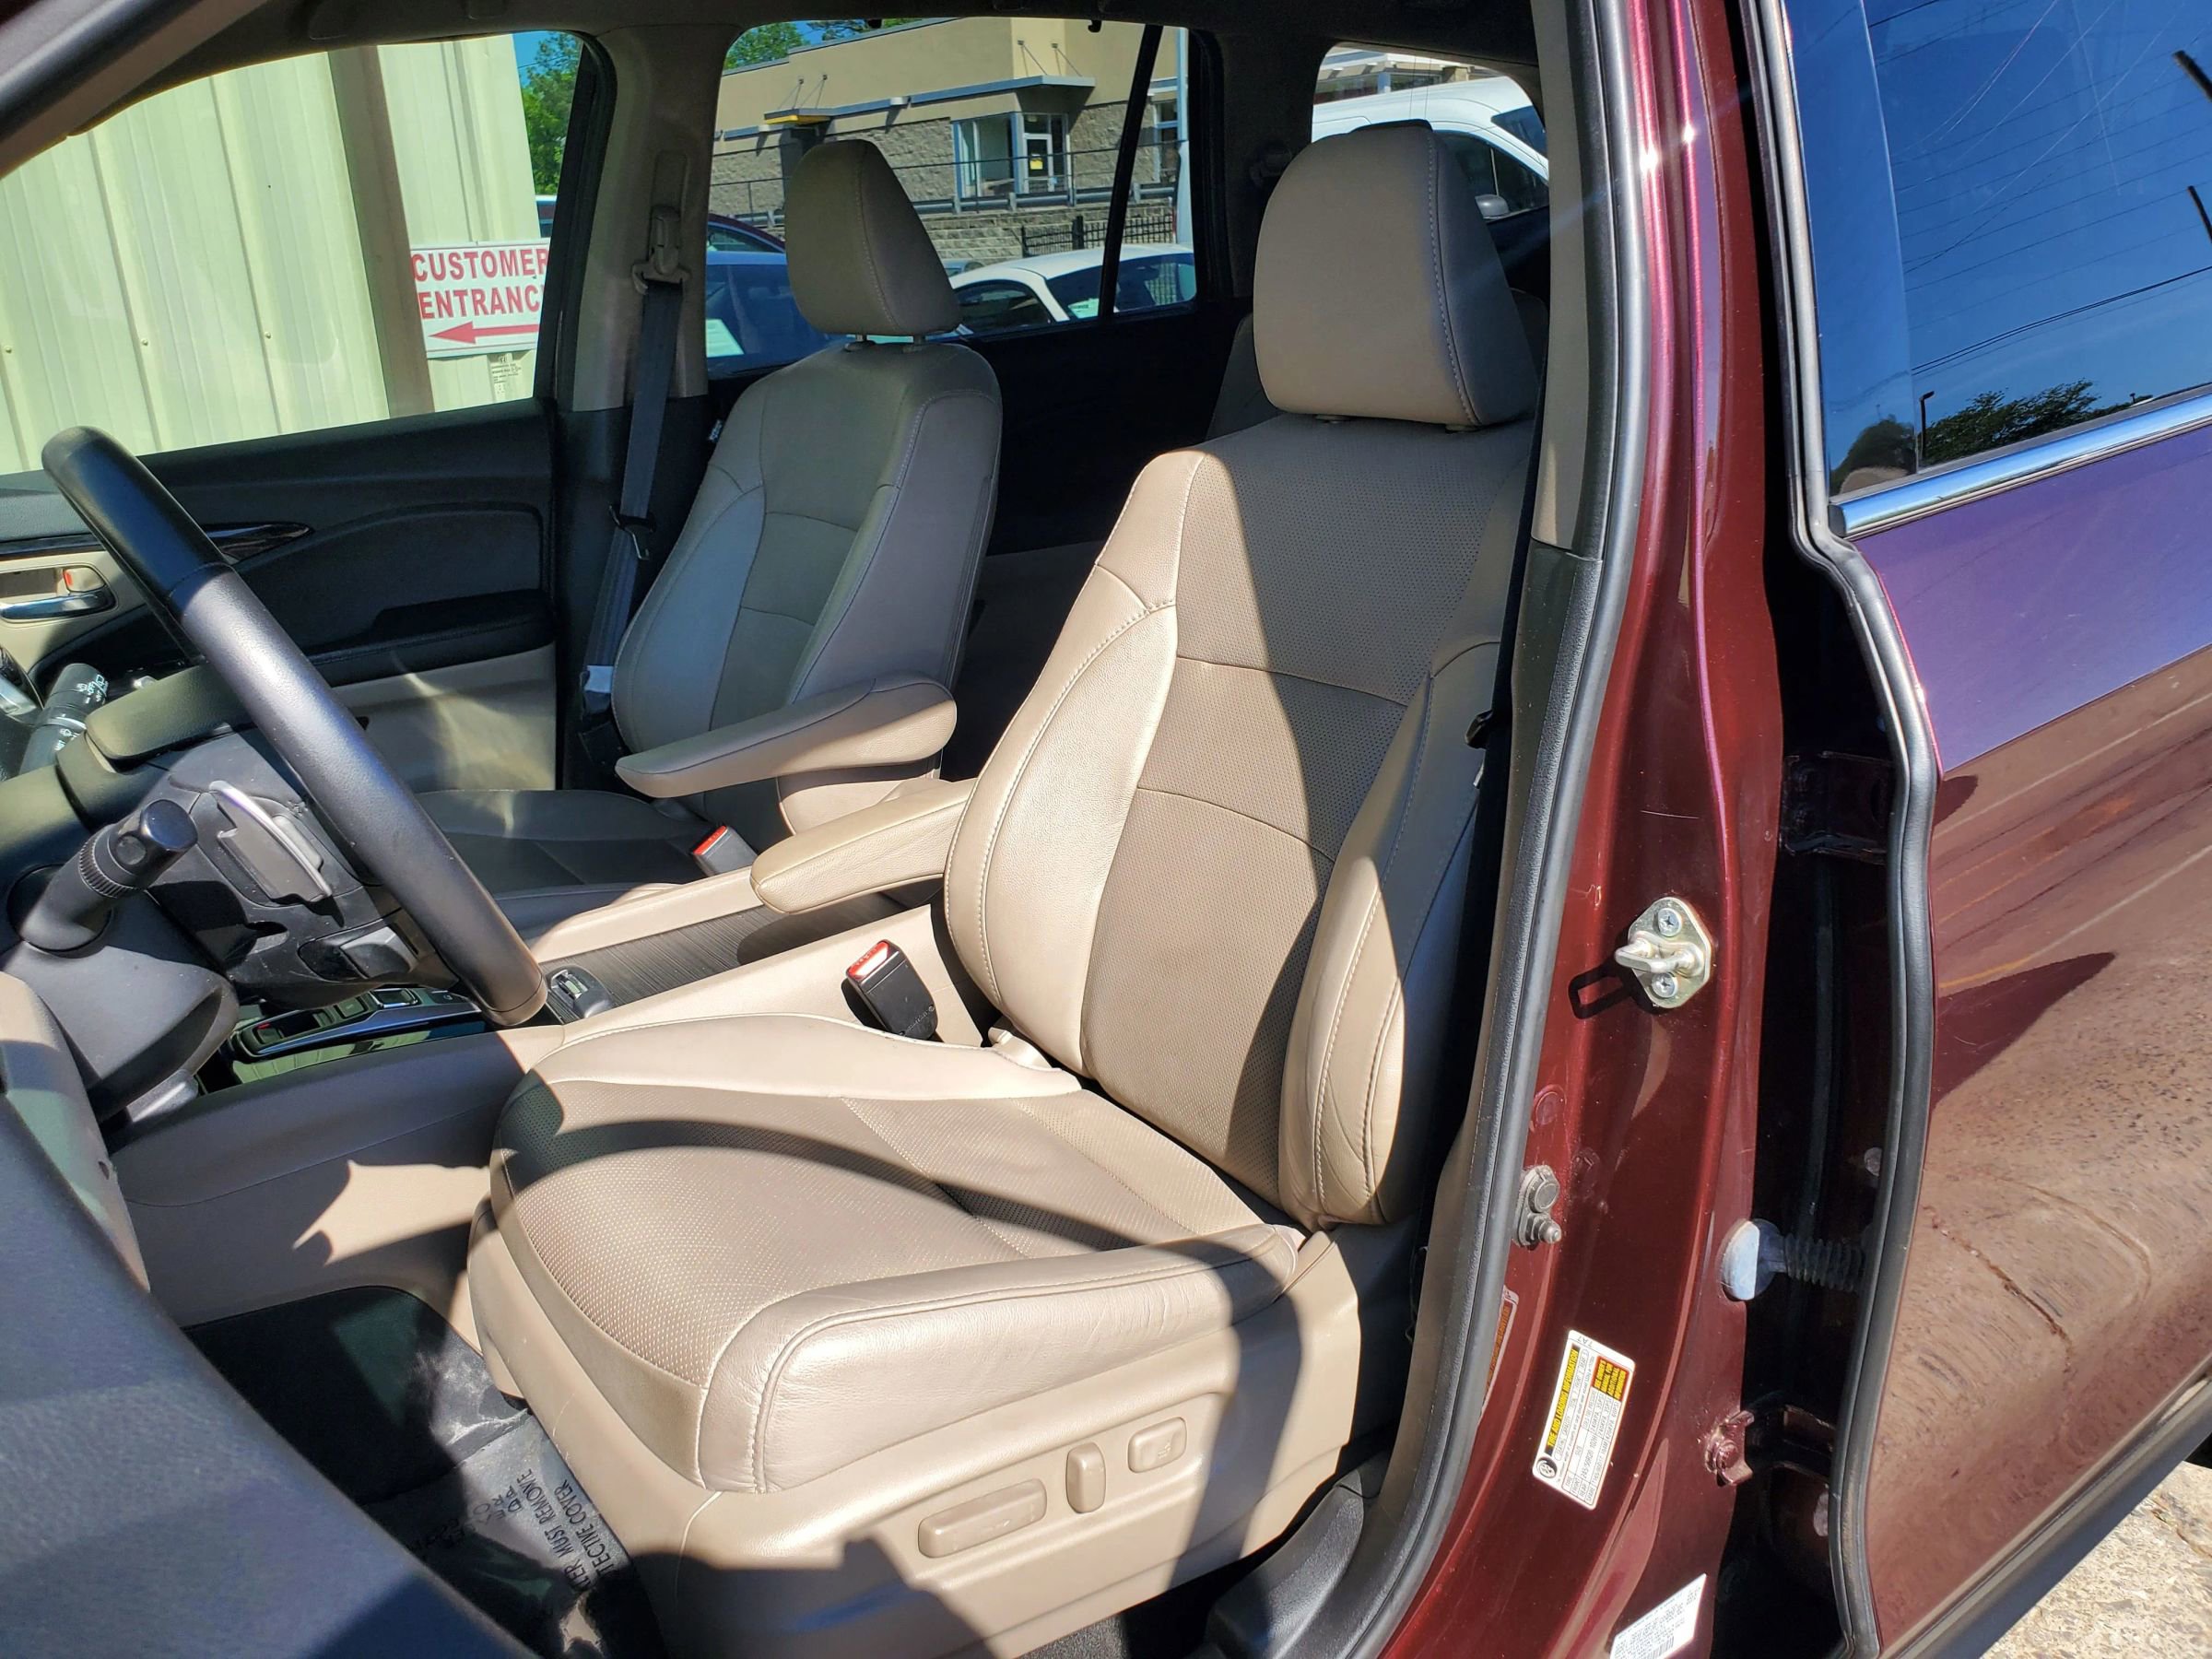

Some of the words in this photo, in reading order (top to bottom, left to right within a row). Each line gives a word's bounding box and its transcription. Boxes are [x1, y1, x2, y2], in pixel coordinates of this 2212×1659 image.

[418, 284, 545, 320] ENTRANC
[1561, 1348, 1579, 1392] INFORMATION
[1554, 1390, 1568, 1418] LOADING
[1547, 1431, 1557, 1448] TIRE
[1550, 1417, 1560, 1434] AND
[517, 1468, 555, 1524] REMOVE
[553, 1479, 587, 1524] COVER
[545, 1525, 575, 1558] MUST
[576, 1524, 615, 1575] TECTIVE
